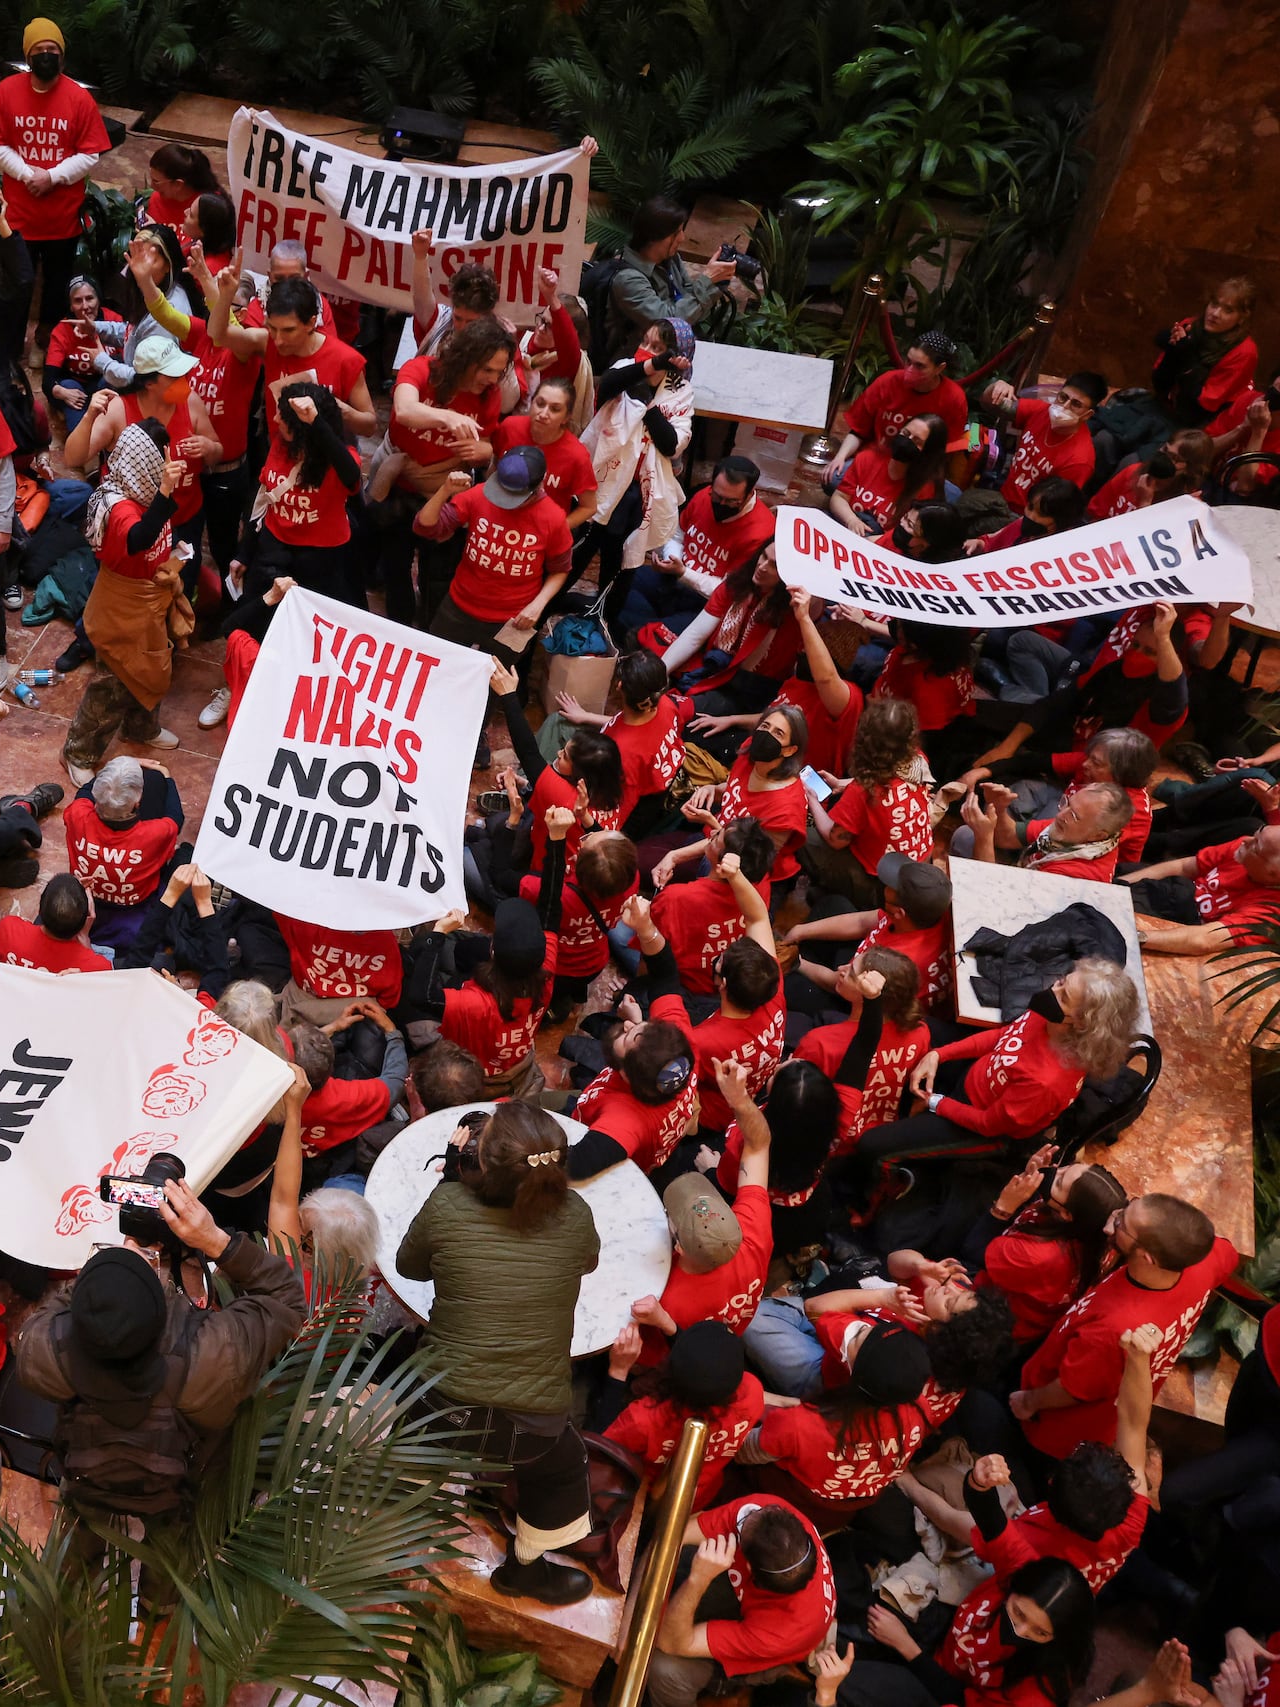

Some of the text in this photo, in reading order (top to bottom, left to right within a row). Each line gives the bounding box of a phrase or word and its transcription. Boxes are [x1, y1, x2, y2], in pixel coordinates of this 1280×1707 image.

[15, 115, 68, 131] NOT IN
[22, 130, 60, 146] OUR
[18, 145, 64, 161] NAME
[243, 124, 574, 241] FREE MAHMOUD
[1037, 456, 1054, 473] IN
[469, 531, 538, 561] ARMING
[475, 517, 539, 548] STOP
[687, 524, 729, 561] NOT IN
[464, 542, 535, 577] ISRAEL
[687, 539, 718, 571] OUR
[793, 518, 1219, 593] OPPOSING FASCISM IS A
[839, 575, 1195, 616] JEWISH TRADITION
[311, 612, 440, 722] FIGHT
[267, 747, 419, 814] NOT
[74, 837, 143, 865] JEWS
[214, 782, 446, 896] STUDENTS
[76, 855, 129, 881] SAY
[311, 944, 386, 972] JEWS
[312, 958, 371, 984] SAY
